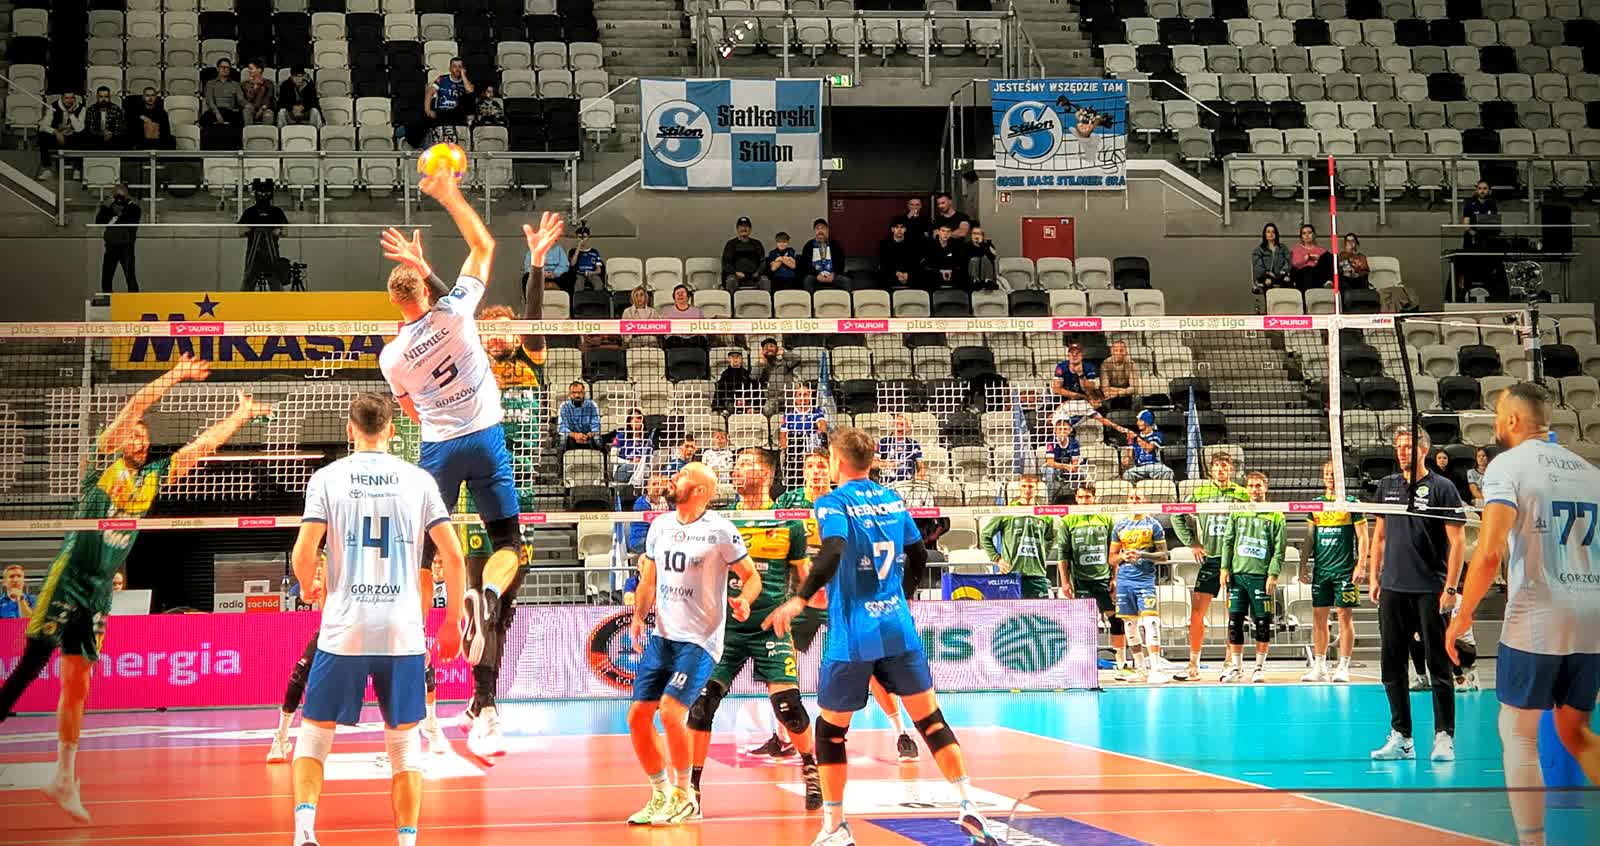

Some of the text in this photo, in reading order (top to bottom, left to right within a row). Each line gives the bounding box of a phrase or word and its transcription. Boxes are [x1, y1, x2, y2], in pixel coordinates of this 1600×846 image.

[993, 80, 1123, 94] JESTEŚMY WSZĘDZIE TAM
[717, 105, 816, 127] Siatkarski
[656, 125, 704, 138] Stilon
[1007, 120, 1055, 138] Stilon
[739, 140, 794, 162] Stilon
[77, 323, 150, 335] plus liga
[244, 323, 271, 334] plus
[308, 322, 379, 333] plus liga
[477, 321, 497, 332] lus
[531, 321, 601, 333] plus liga
[636, 323, 667, 331] TAURON
[690, 320, 717, 332] plus
[751, 319, 819, 332] plus liga
[907, 319, 933, 331] plus
[967, 319, 1034, 331] plus liga
[1120, 318, 1146, 329] plus
[1179, 317, 1245, 329] plus liga
[11, 324, 40, 336] plus
[404, 327, 450, 361] NIEMIEC
[431, 355, 459, 388] 5
[350, 473, 399, 486] HENNO
[1551, 501, 1599, 546] 77
[362, 516, 390, 559] 4
[664, 551, 686, 572] 10
[872, 541, 895, 580] 7
[350, 582, 401, 594] GORZÓW
[219, 599, 279, 609] radio zachód
[433, 597, 447, 608] 13
[54, 642, 242, 686] nergia
[784, 657, 797, 677] 2
[673, 672, 688, 687] 10
